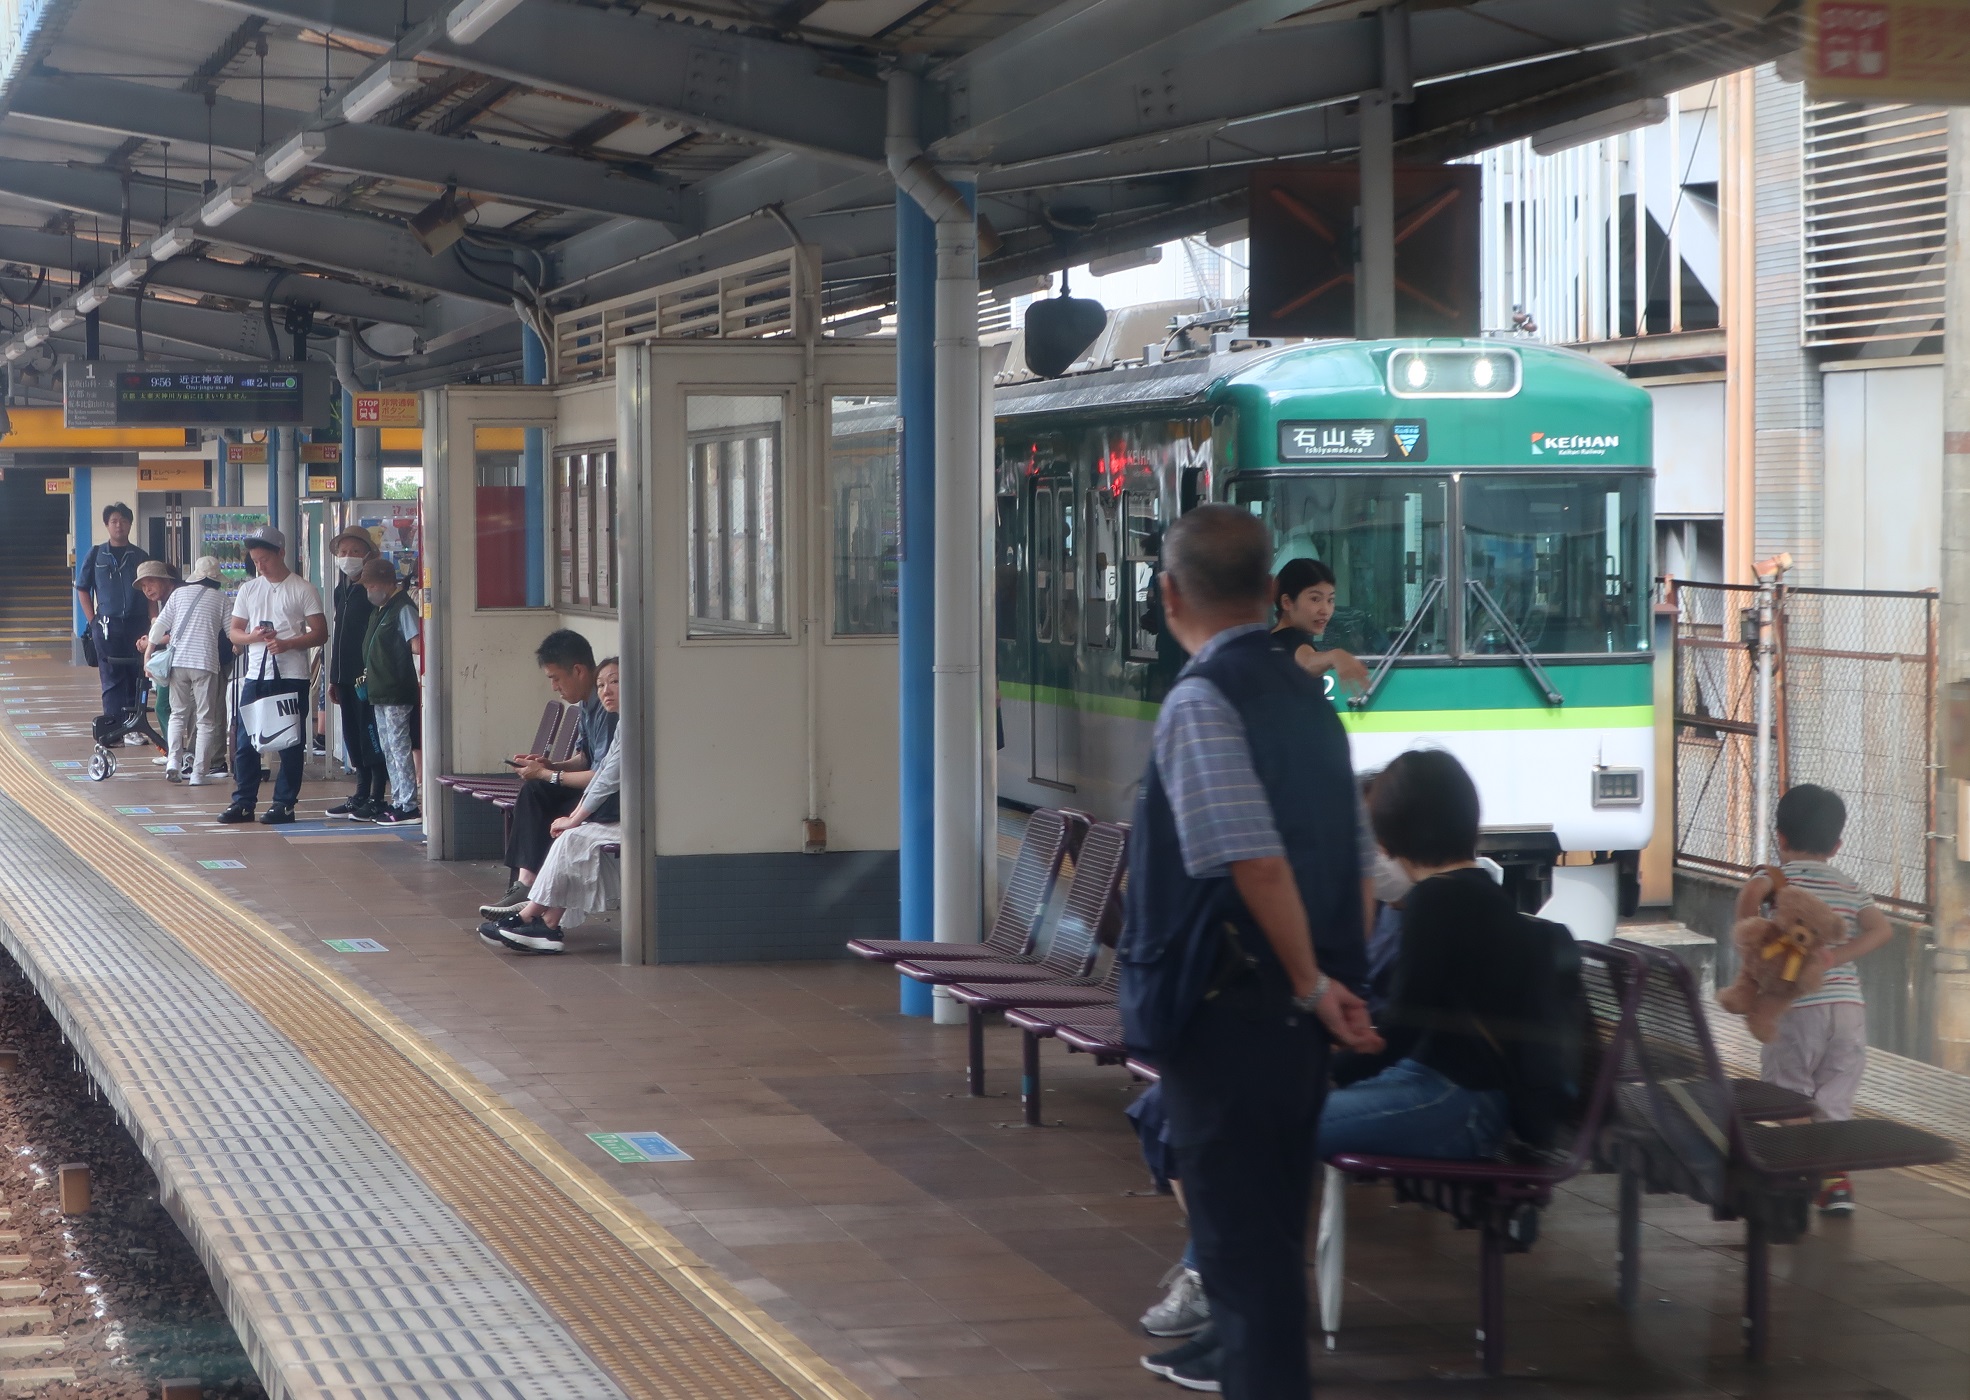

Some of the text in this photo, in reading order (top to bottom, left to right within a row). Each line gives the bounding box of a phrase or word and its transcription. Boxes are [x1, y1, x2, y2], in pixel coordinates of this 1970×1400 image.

[86, 364, 96, 379] 1
[151, 377, 172, 388] 9:56
[179, 374, 235, 385] 近江神宮前
[381, 398, 416, 407] 非常通報
[381, 408, 406, 416] ボタン
[1293, 427, 1376, 447] 石山寺
[1544, 435, 1619, 449] KEIHAN
[1305, 447, 1363, 455] Ishiyamadera
